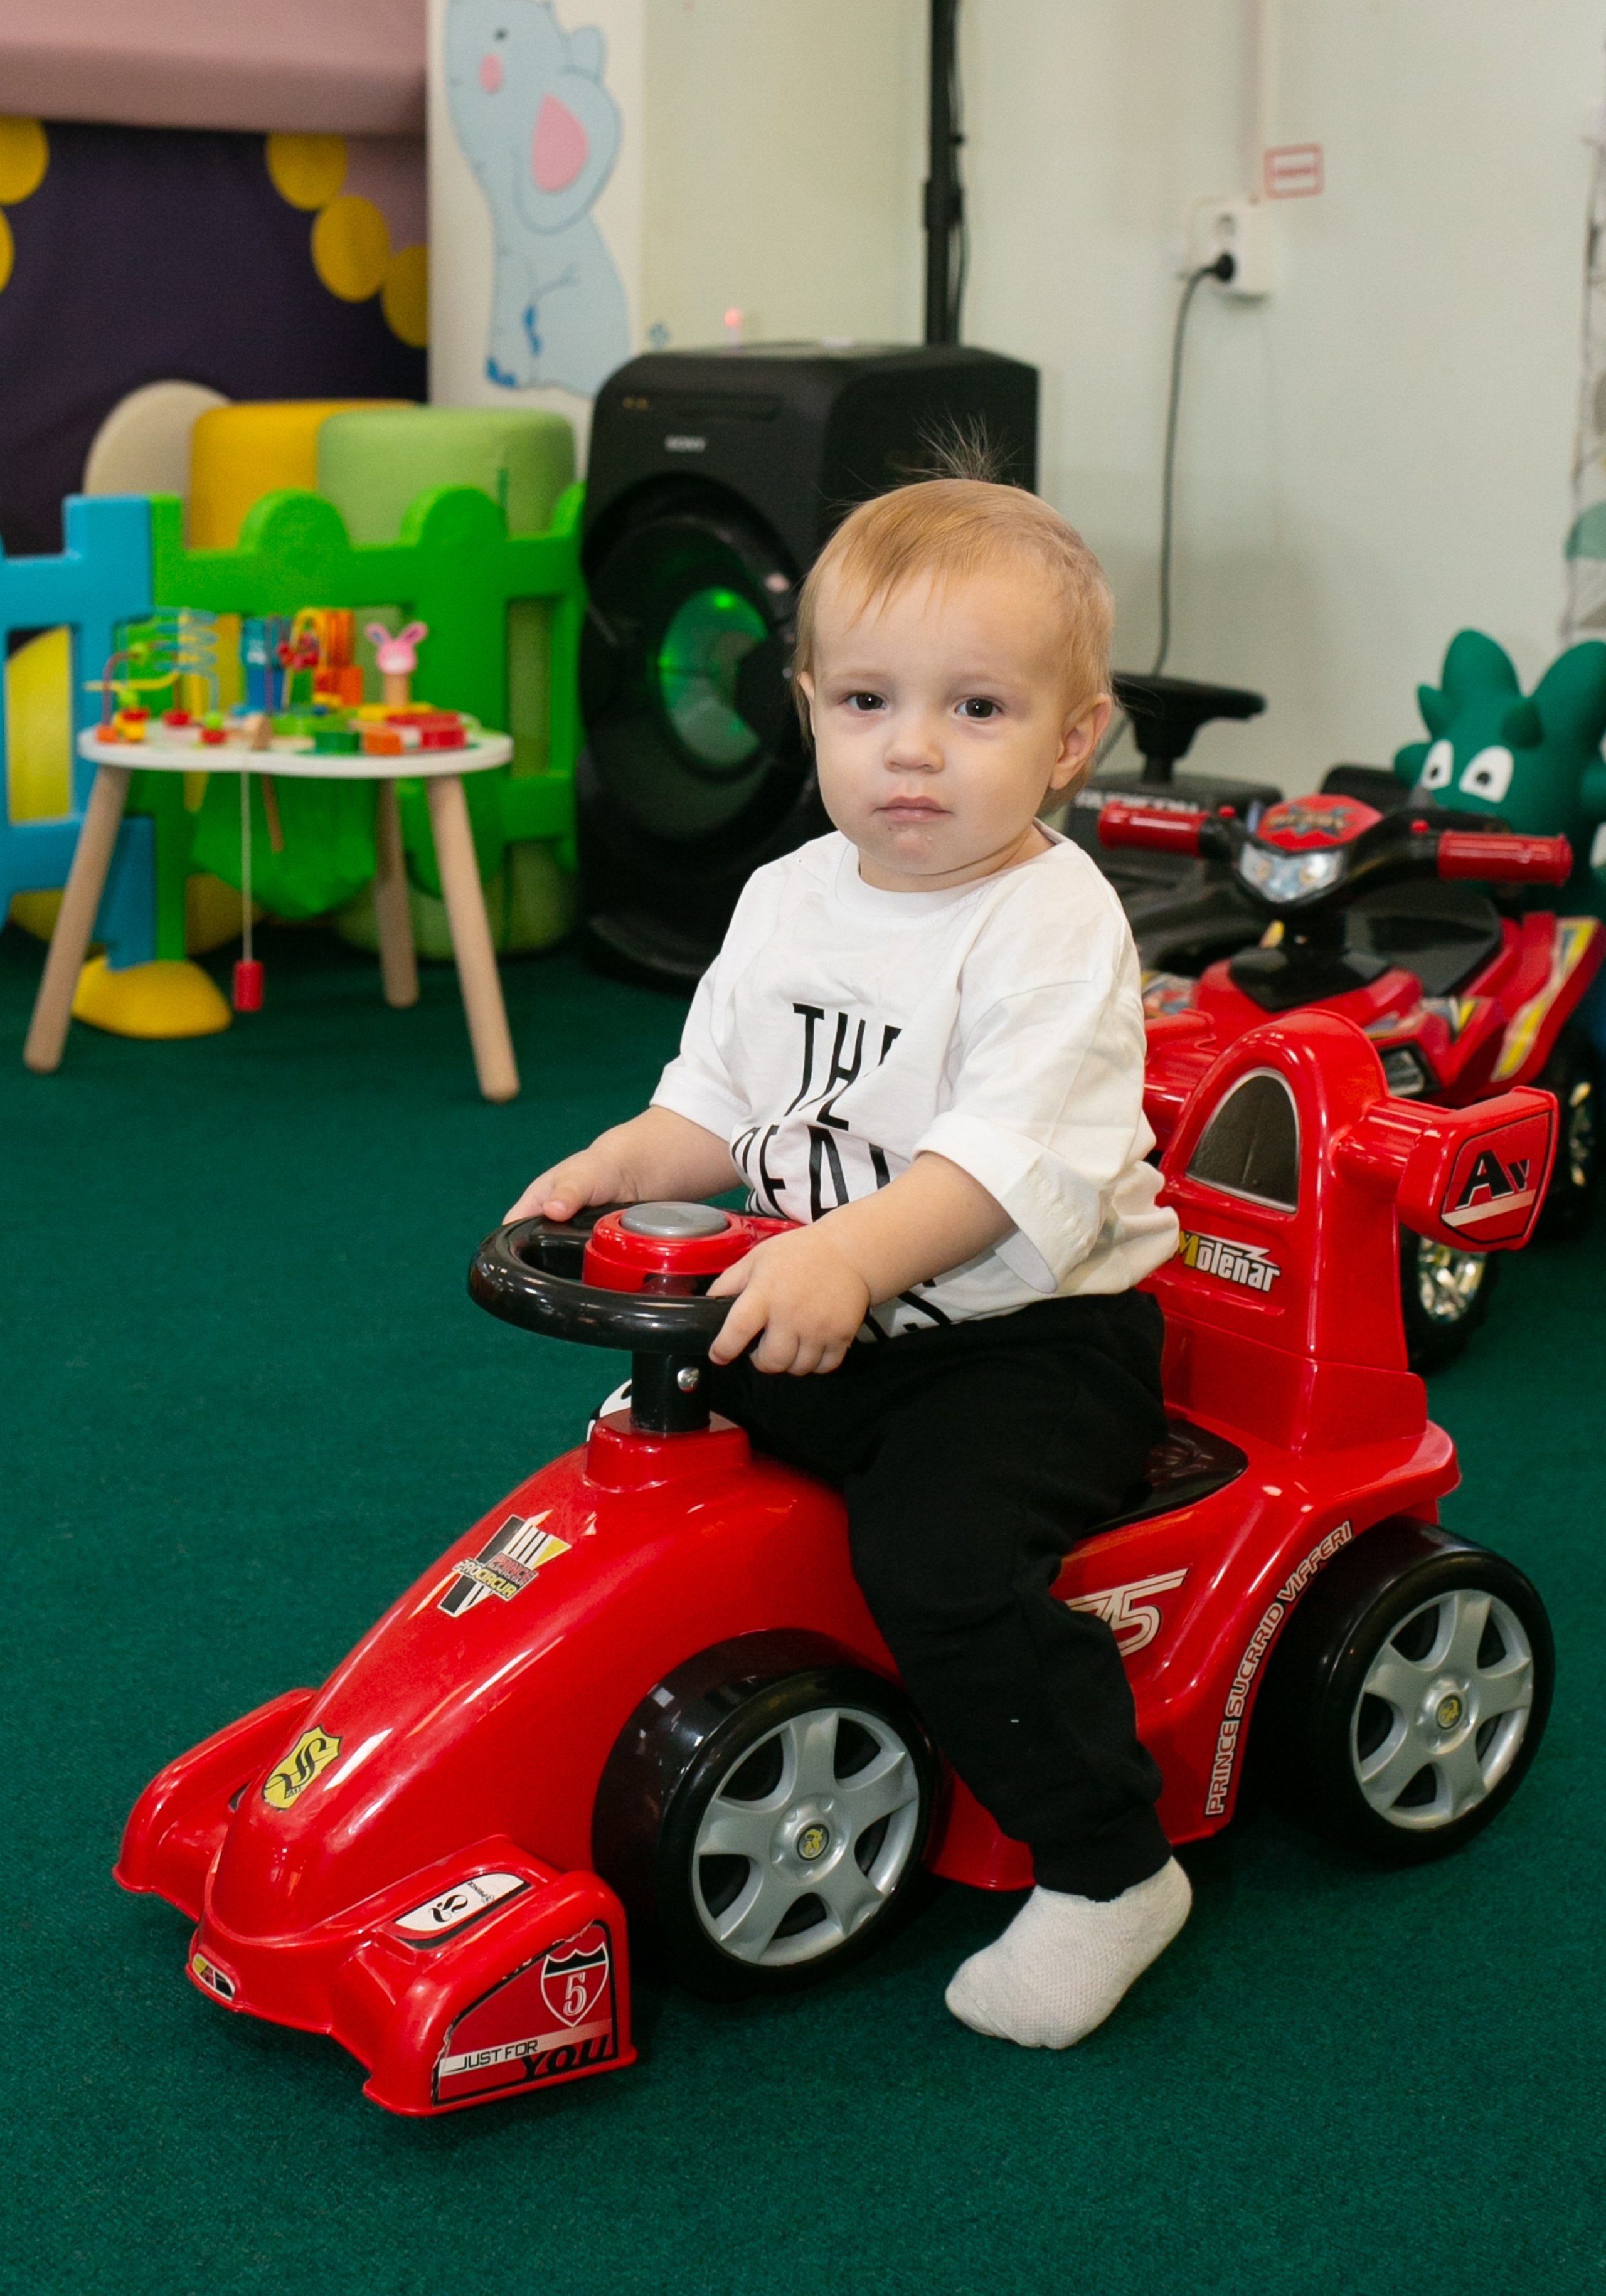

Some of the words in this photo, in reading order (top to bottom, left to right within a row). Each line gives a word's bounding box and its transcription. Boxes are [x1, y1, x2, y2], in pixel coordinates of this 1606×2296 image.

[1205, 1720, 1240, 1815] PRINCE
[1225, 1602, 1285, 1717] SUCRRID
[563, 1972, 587, 2016] 5
[449, 2048, 503, 2073] JUST
[504, 2039, 538, 2060] FOR
[520, 2034, 609, 2081] YOU
